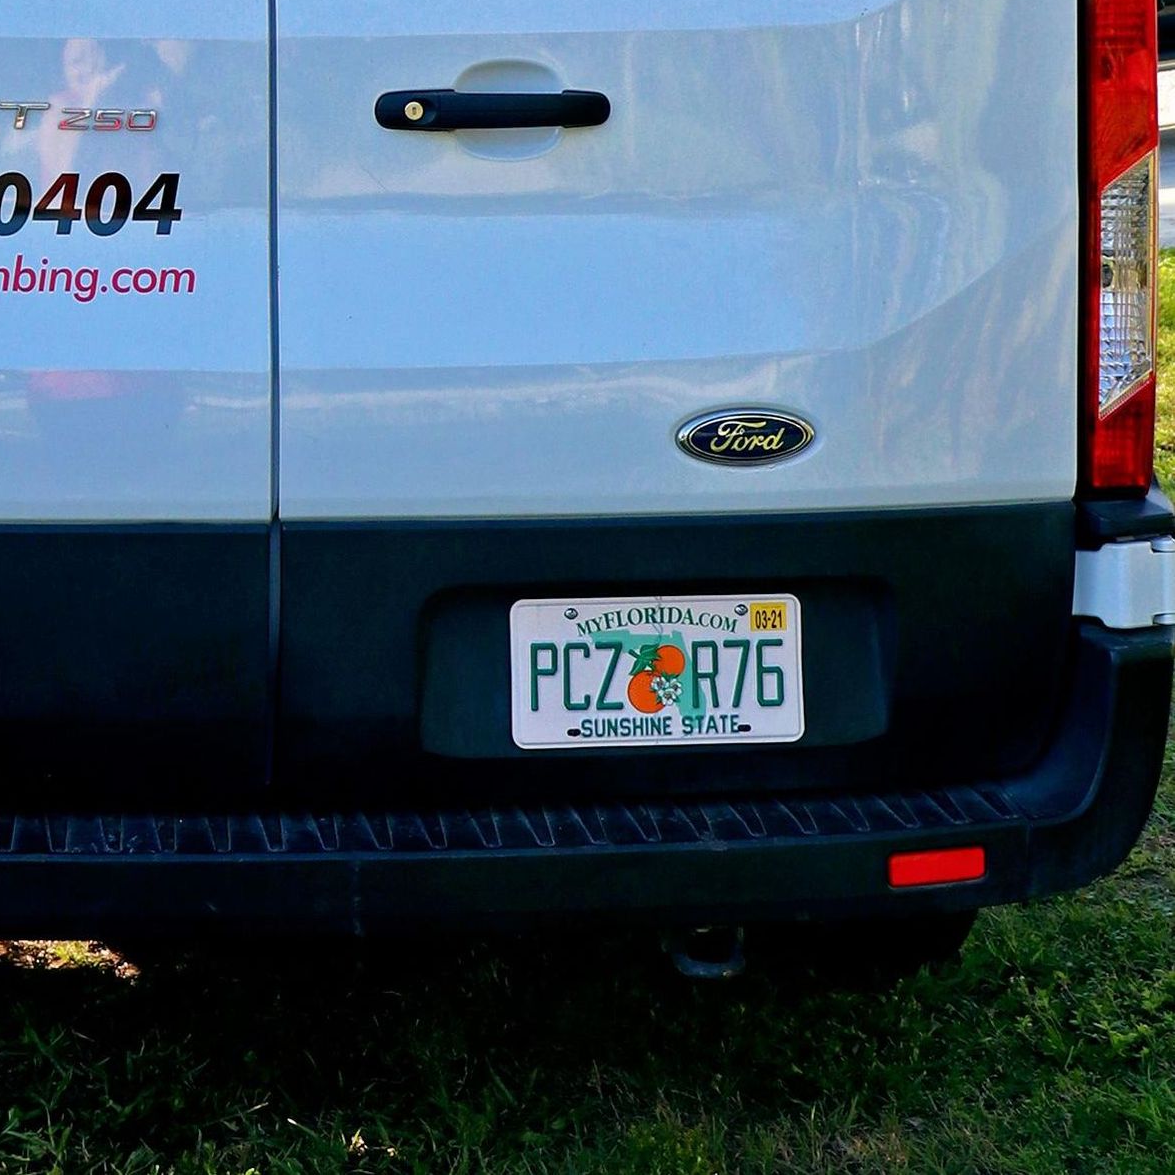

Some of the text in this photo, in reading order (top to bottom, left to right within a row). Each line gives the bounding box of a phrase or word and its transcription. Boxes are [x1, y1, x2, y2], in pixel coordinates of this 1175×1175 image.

[57, 106, 158, 131] 250
[710, 420, 785, 453] Ford
[576, 606, 783, 637] MYFLORIDA.COM 03-21
[530, 638, 784, 712] PCZ R76
[580, 713, 739, 738] SUNSHINE STATE
